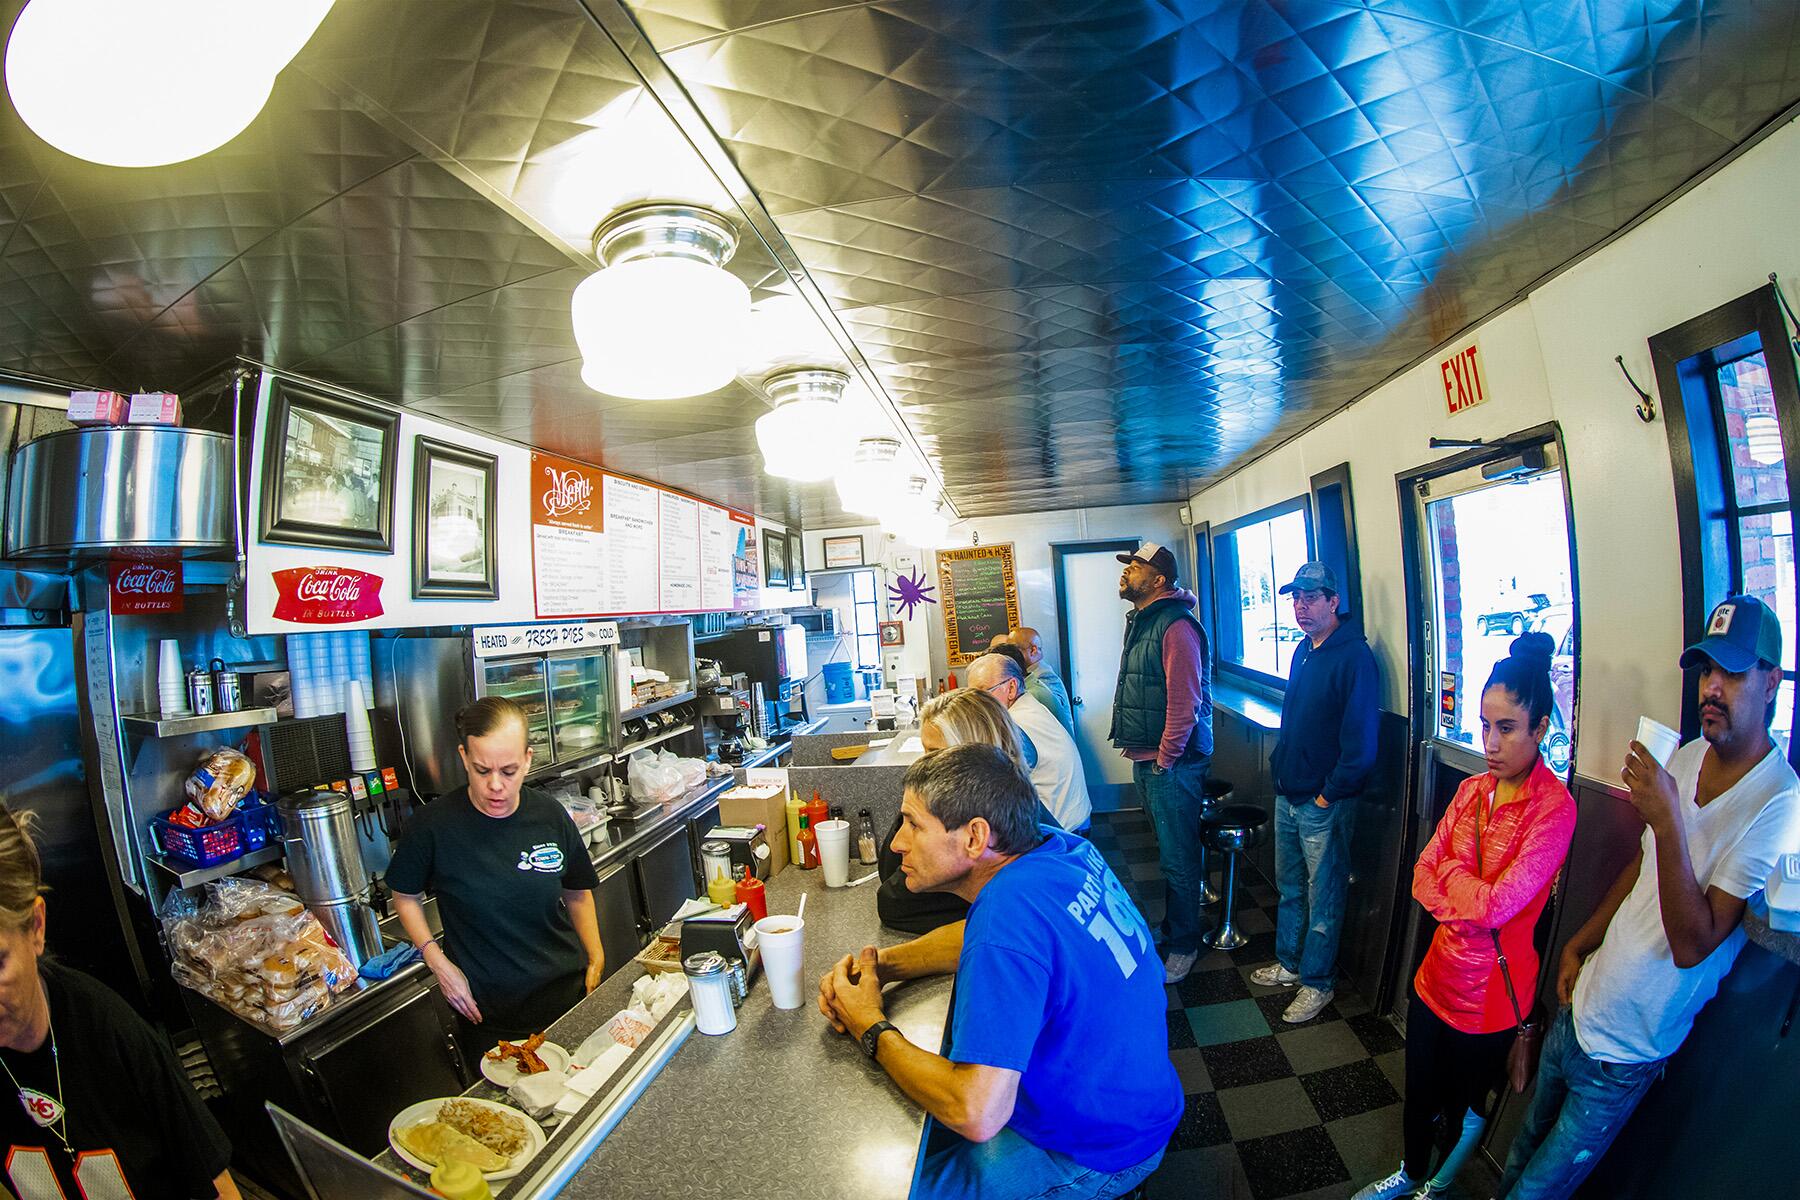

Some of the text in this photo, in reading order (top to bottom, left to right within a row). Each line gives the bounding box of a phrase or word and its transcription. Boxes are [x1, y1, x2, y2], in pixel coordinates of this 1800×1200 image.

[1441, 345, 1483, 413] EXIT
[543, 467, 594, 517] Menu
[954, 548, 987, 560] HAUNTED
[116, 569, 176, 594] Coca-Cola
[297, 573, 362, 601] Coca-Cola
[134, 601, 171, 609] BOTTLES
[317, 609, 356, 618] BOTTLES
[1717, 607, 1730, 617] Lite
[480, 634, 508, 649] HEATED
[525, 627, 584, 649] FRESH PIES
[598, 628, 614, 640] COLD
[947, 617, 959, 650] HAUNTED
[1442, 715, 1455, 726] VISA
[28, 1097, 55, 1119] KC
